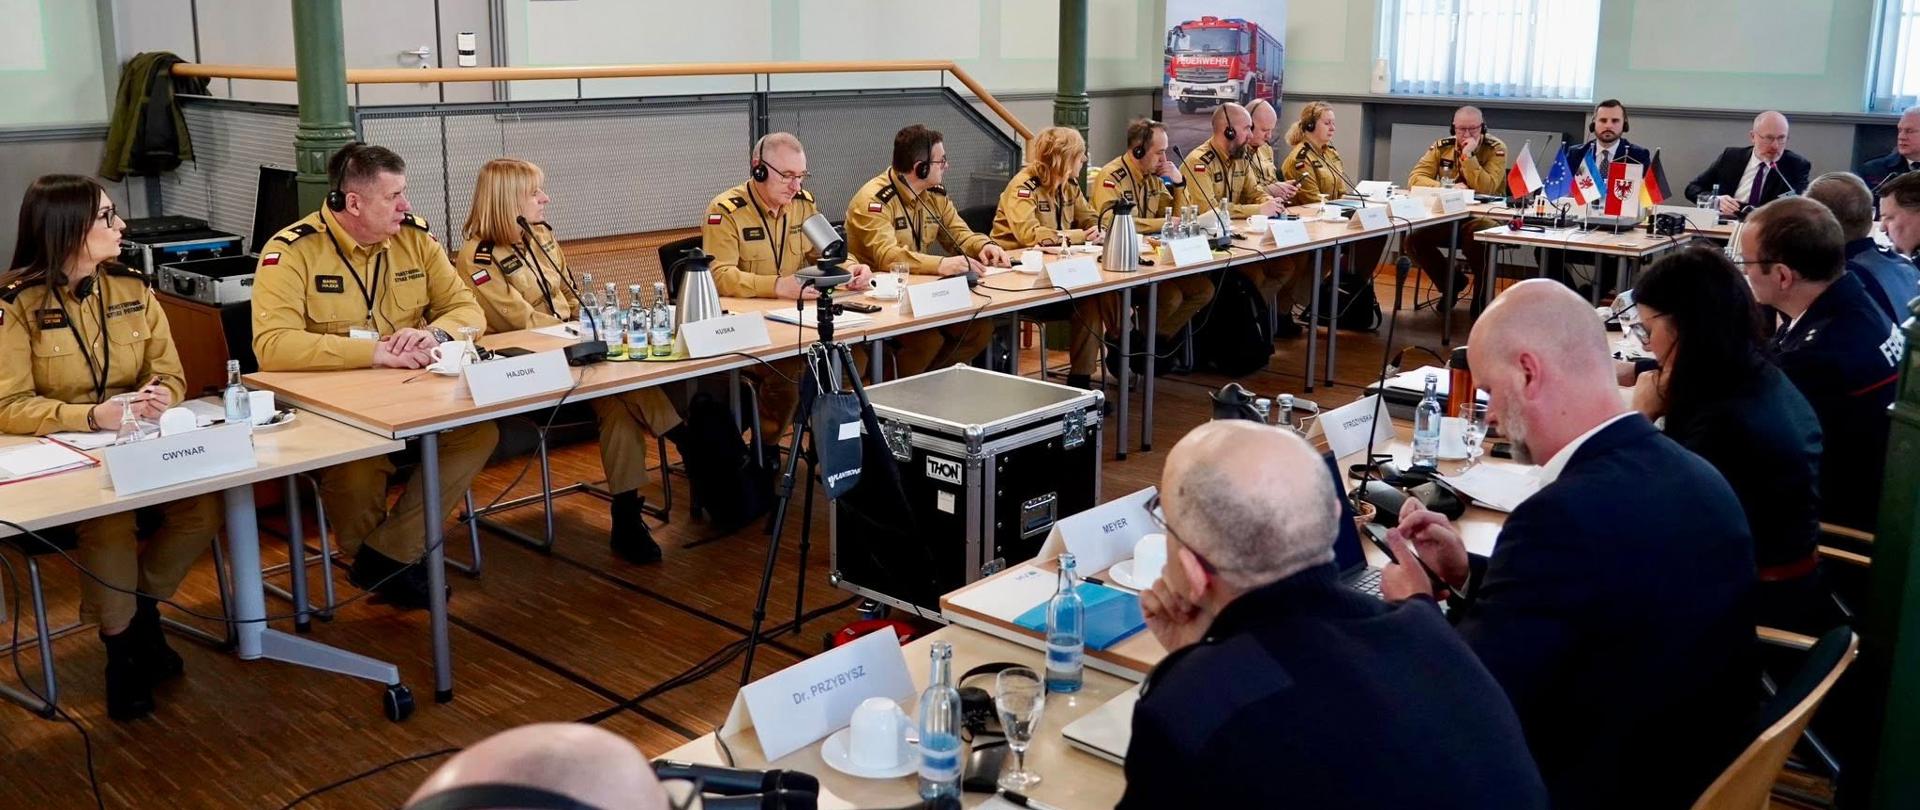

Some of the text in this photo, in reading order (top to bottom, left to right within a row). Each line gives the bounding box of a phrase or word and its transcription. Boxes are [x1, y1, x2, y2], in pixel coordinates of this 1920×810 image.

[1176, 56, 1229, 65] FEUERWEHR
[714, 326, 735, 335] KUSKA
[505, 367, 535, 379] HAJDUK
[162, 445, 206, 461] CWYNAR
[928, 457, 959, 480] THON
[1102, 517, 1128, 534] MEYER
[792, 665, 867, 705] Dr. PRZYBYSZ
